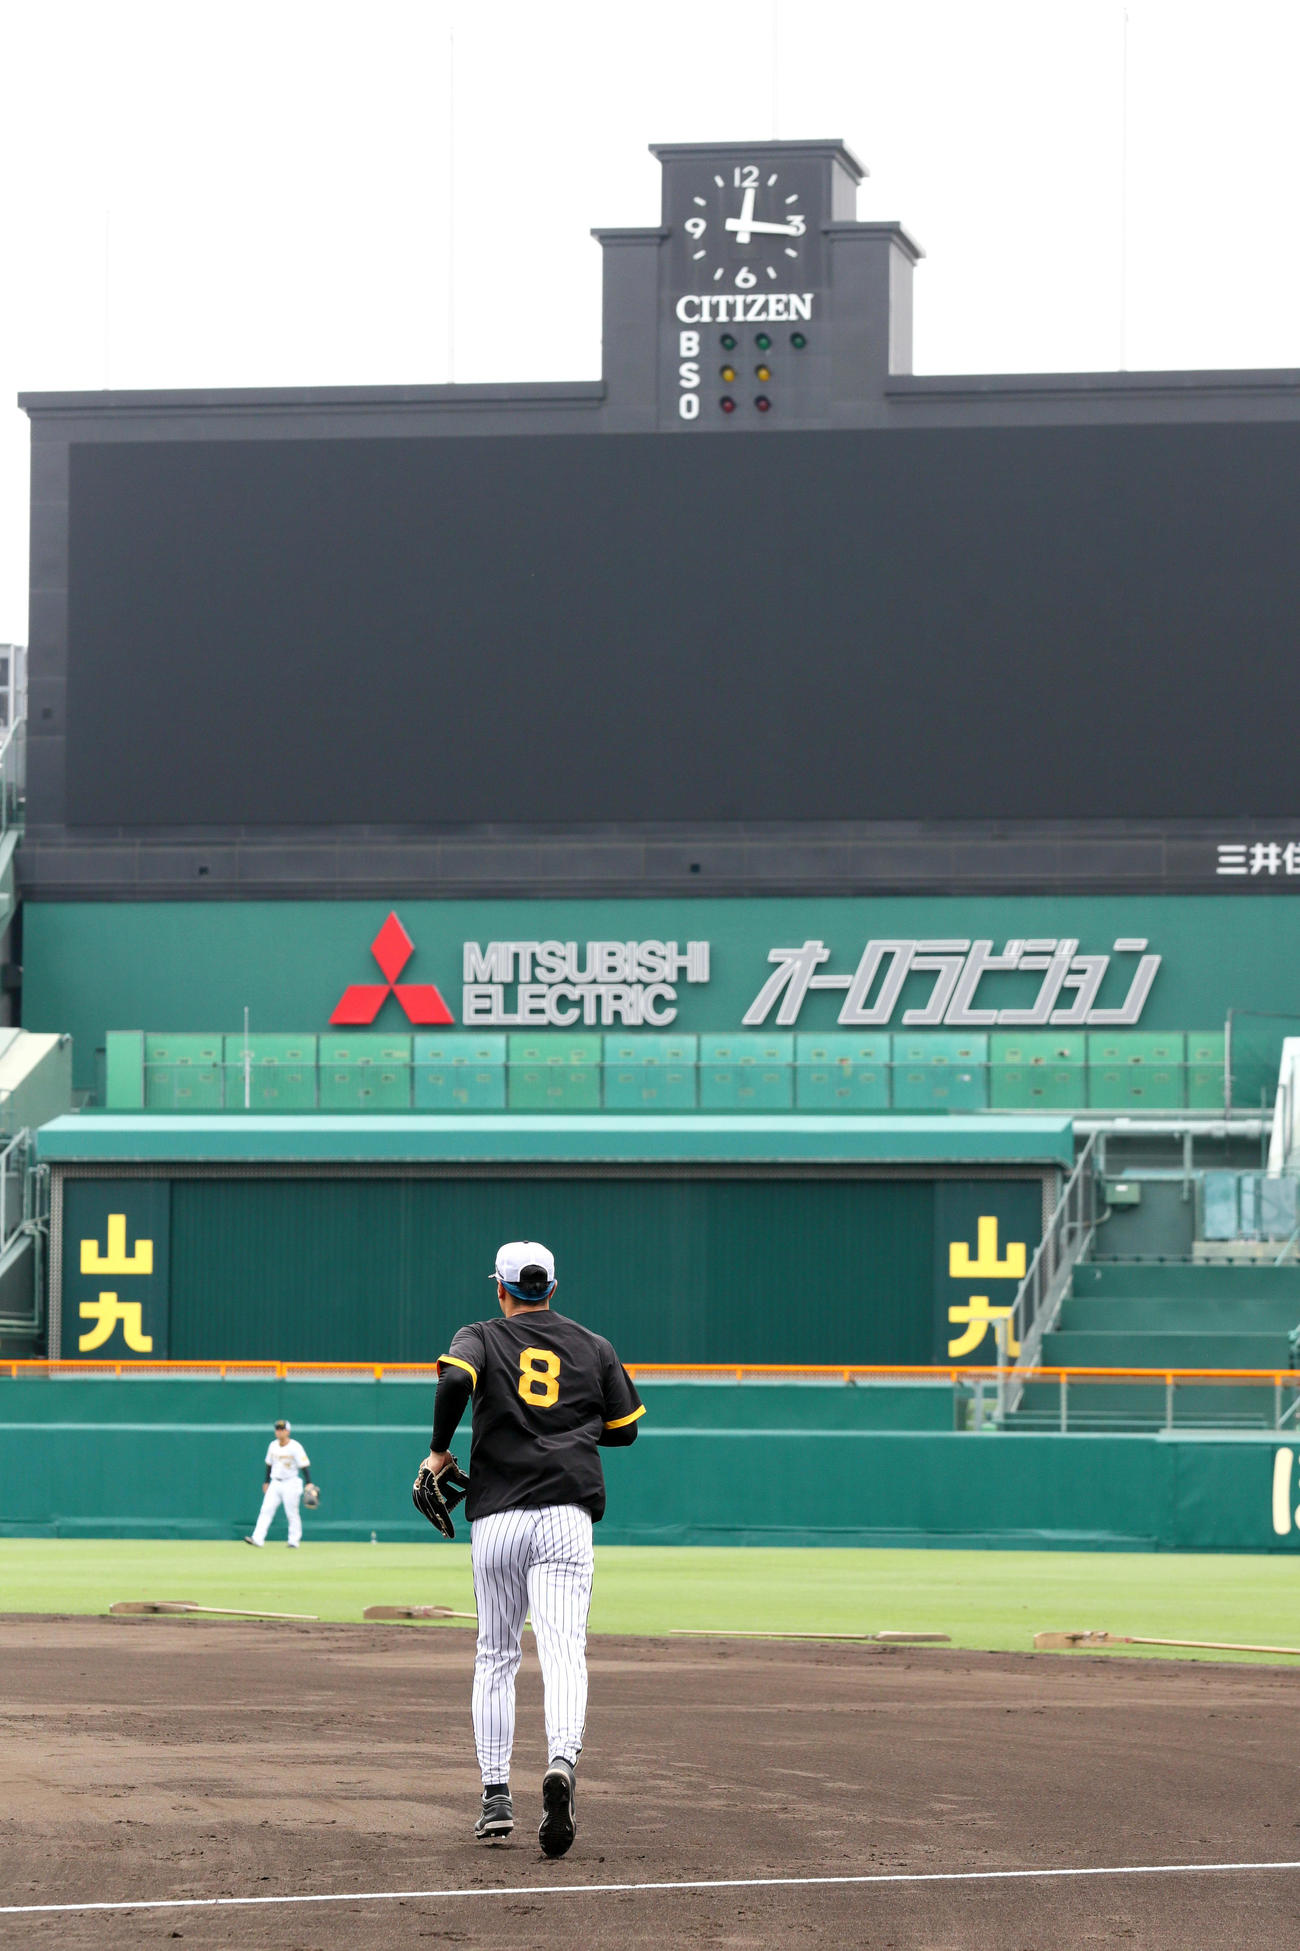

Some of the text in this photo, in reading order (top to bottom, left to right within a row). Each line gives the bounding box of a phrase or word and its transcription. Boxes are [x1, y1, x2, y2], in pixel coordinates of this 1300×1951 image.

[734, 165, 759, 188] 12
[684, 217, 707, 239] 9
[786, 214, 806, 236] 3
[734, 266, 757, 289] 6
[676, 294, 813, 322] CITIZEN
[679, 330, 700, 357] B
[679, 362, 700, 389] S
[679, 393, 700, 420] O
[462, 941, 710, 983] MITSUBISHI
[742, 937, 1162, 1027] オーロラビジョン
[462, 983, 678, 1027] ELECTRIC
[79, 1214, 153, 1353] 山九
[518, 1346, 561, 1408] 8
